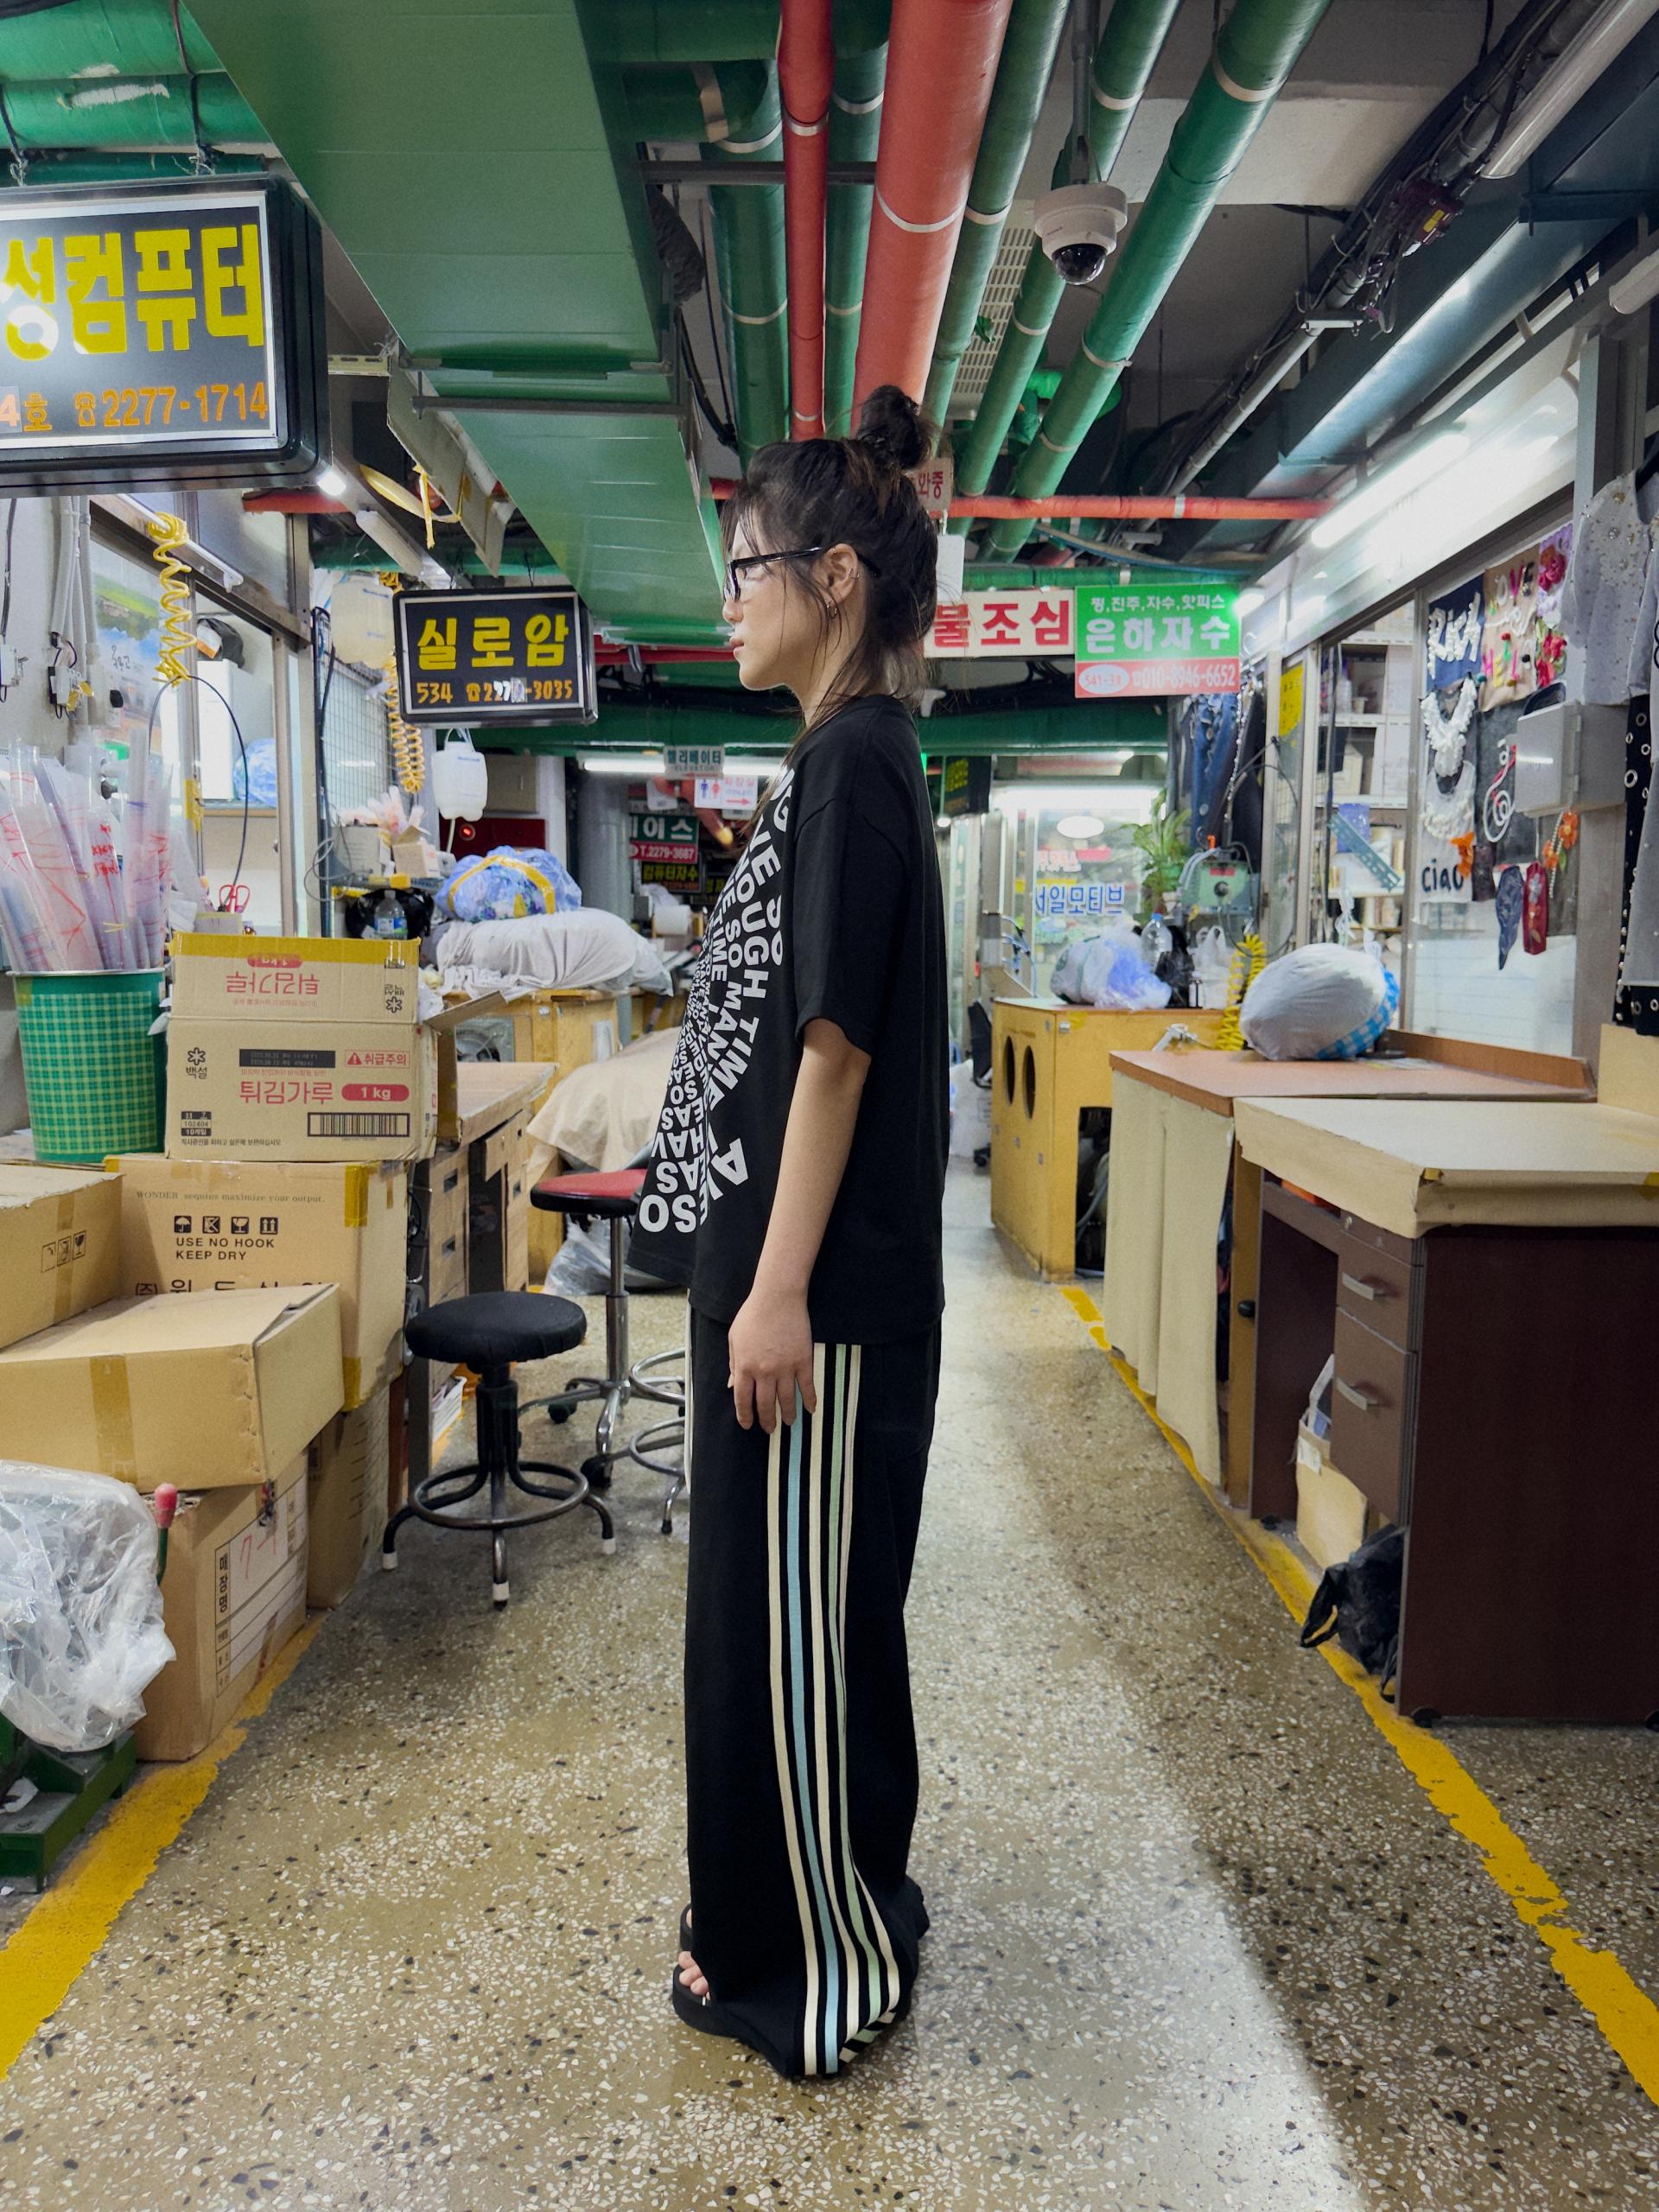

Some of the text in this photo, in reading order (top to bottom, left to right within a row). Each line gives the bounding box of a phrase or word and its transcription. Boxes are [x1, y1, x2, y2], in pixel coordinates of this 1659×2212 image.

[3, 224, 264, 361] 성컴퓨터
[932, 601, 1069, 648] 불조심
[1086, 615, 1230, 654] 은하자수
[417, 613, 569, 671] 실로암
[416, 682, 454, 704] 534
[632, 817, 693, 840] 이스
[365, 1052, 407, 1065] 취급주의
[186, 1066, 207, 1079] 백설
[239, 1081, 334, 1105] 튀김가루
[372, 1085, 391, 1102] kg
[137, 1191, 178, 1199] WONDER
[639, 1194, 696, 1233] SO
[176, 1237, 275, 1249] USE NO HOOK
[176, 1250, 247, 1261] KEEP DRY
